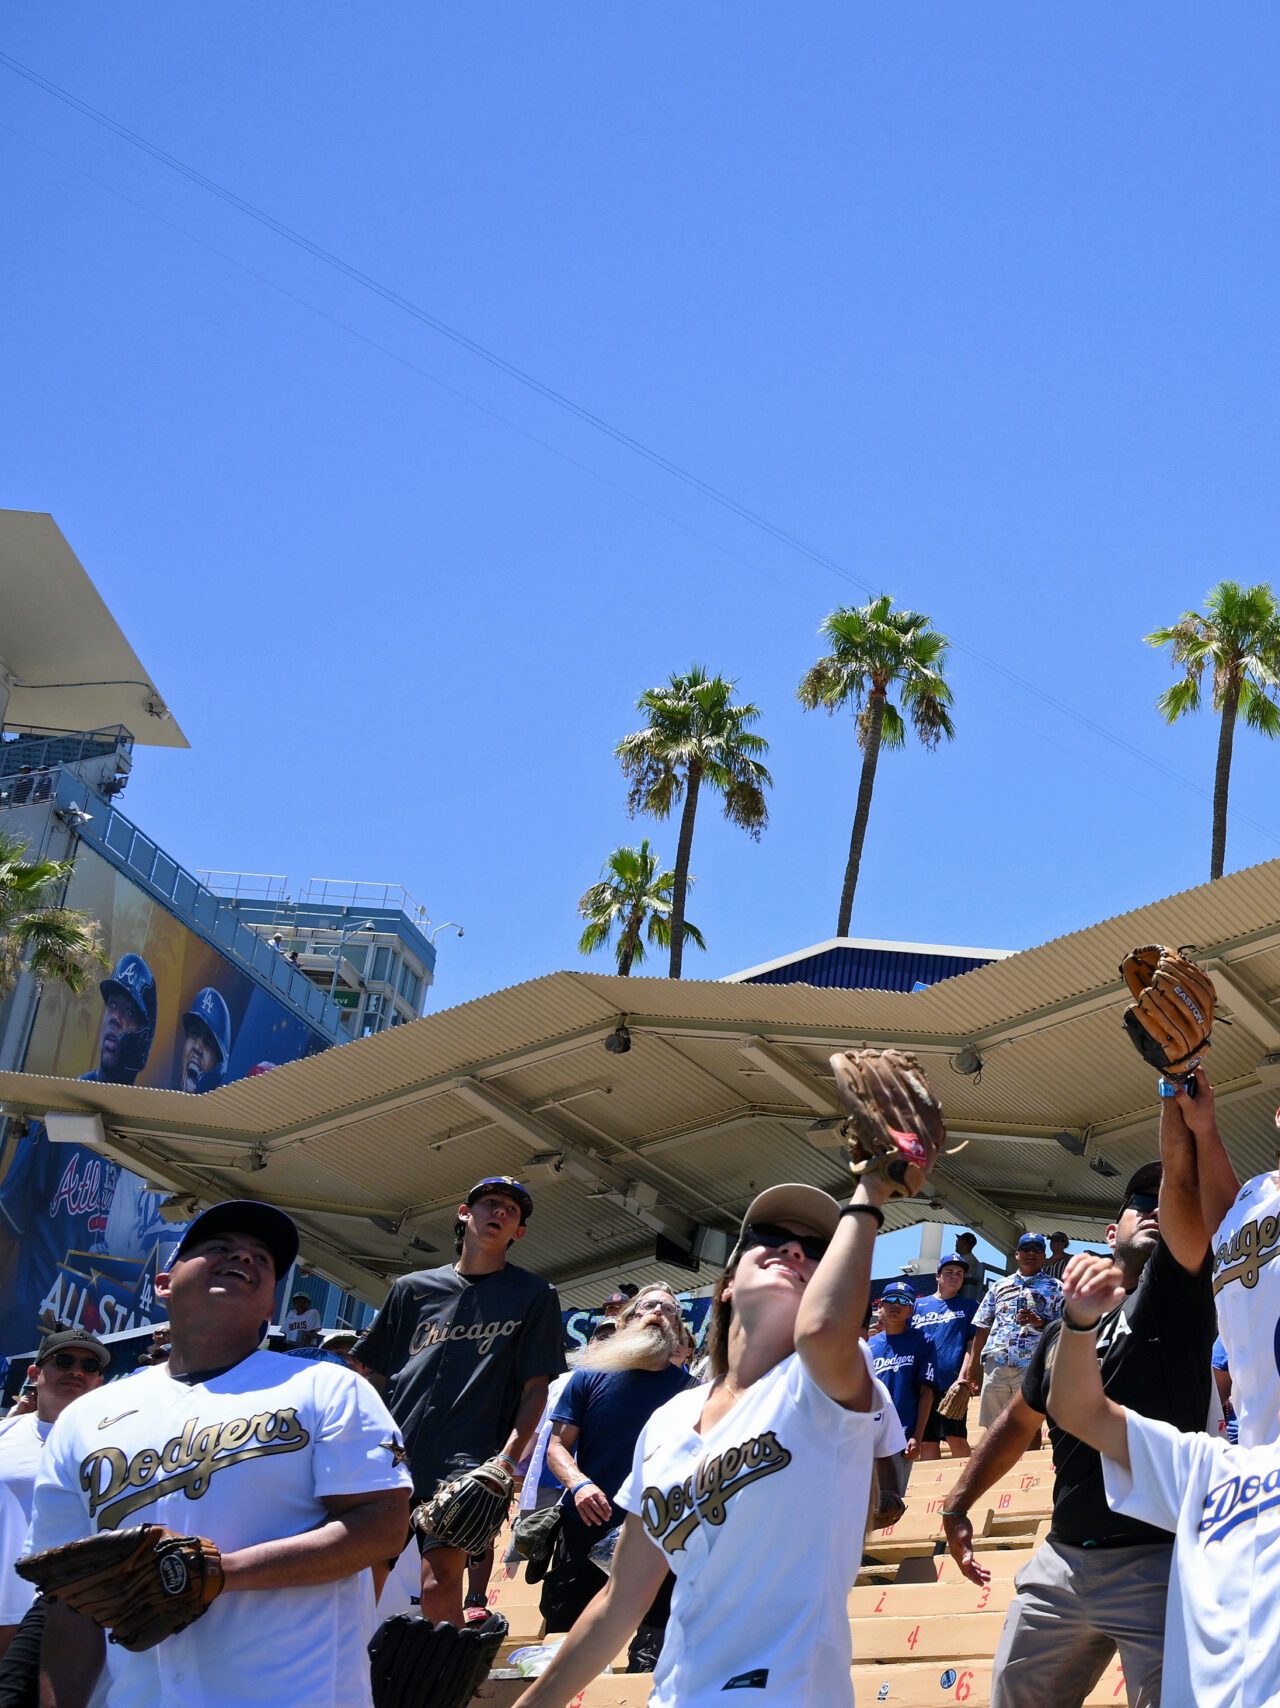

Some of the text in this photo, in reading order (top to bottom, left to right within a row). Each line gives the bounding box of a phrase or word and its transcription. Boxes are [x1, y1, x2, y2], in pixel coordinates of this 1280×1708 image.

[1173, 985, 1205, 1025] EASTON
[39, 1272, 88, 1331] ALL
[139, 1273, 153, 1312] LA
[926, 1310, 966, 1324] Dodgers
[408, 1320, 522, 1356] Chicago
[873, 1354, 915, 1373] Dodgers
[925, 1363, 934, 1382] LA
[80, 1408, 309, 1519] Dodgers
[641, 1431, 792, 1526] Dodgers
[442, 1503, 461, 1526] A2000
[998, 1494, 1012, 1510] 18
[977, 1586, 991, 1608] 3
[907, 1625, 920, 1650] 4
[955, 1671, 974, 1701] 6
